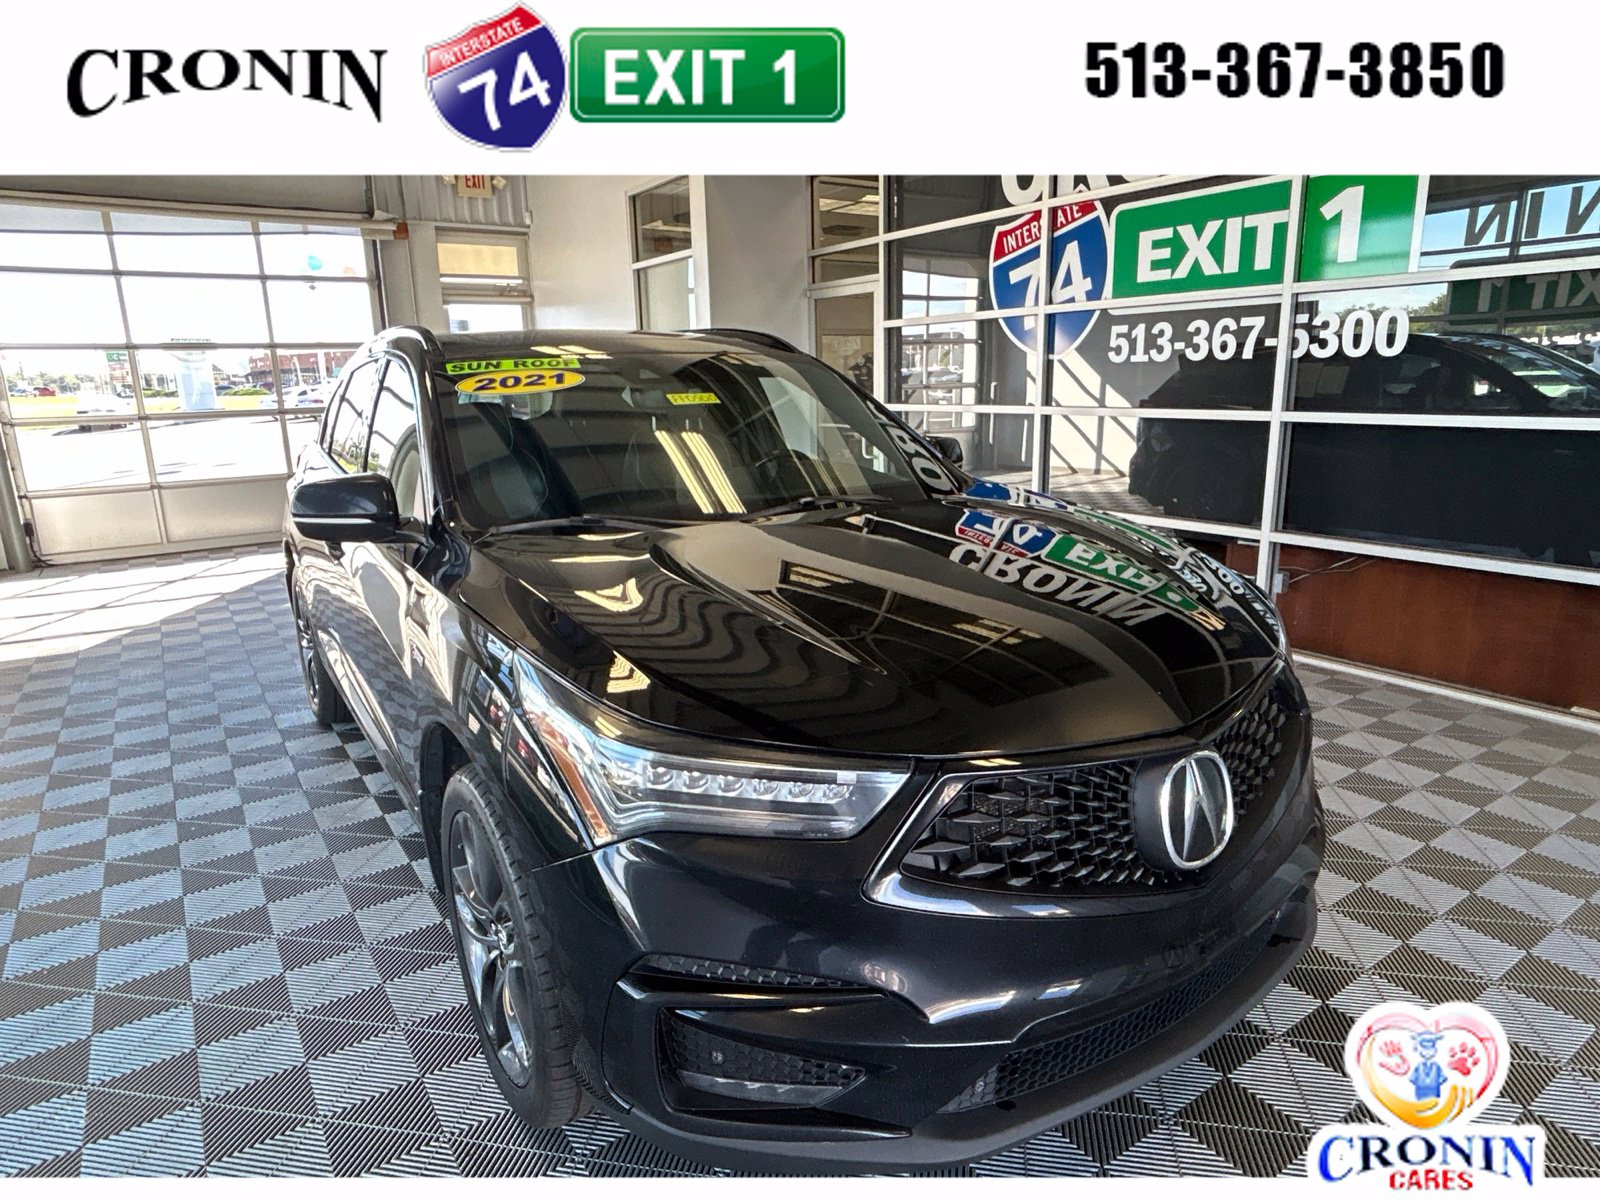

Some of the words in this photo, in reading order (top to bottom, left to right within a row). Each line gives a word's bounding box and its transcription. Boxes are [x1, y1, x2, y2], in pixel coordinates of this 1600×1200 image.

[1002, 203, 1083, 255] INTERATE
[1137, 209, 1290, 283] EXIT
[1320, 185, 1365, 263] 1
[1008, 240, 1093, 331] 74
[1107, 308, 1410, 364] 513-367-5300
[450, 360, 502, 373] SUN
[513, 358, 576, 369] ROOF
[473, 373, 564, 391] 2021
